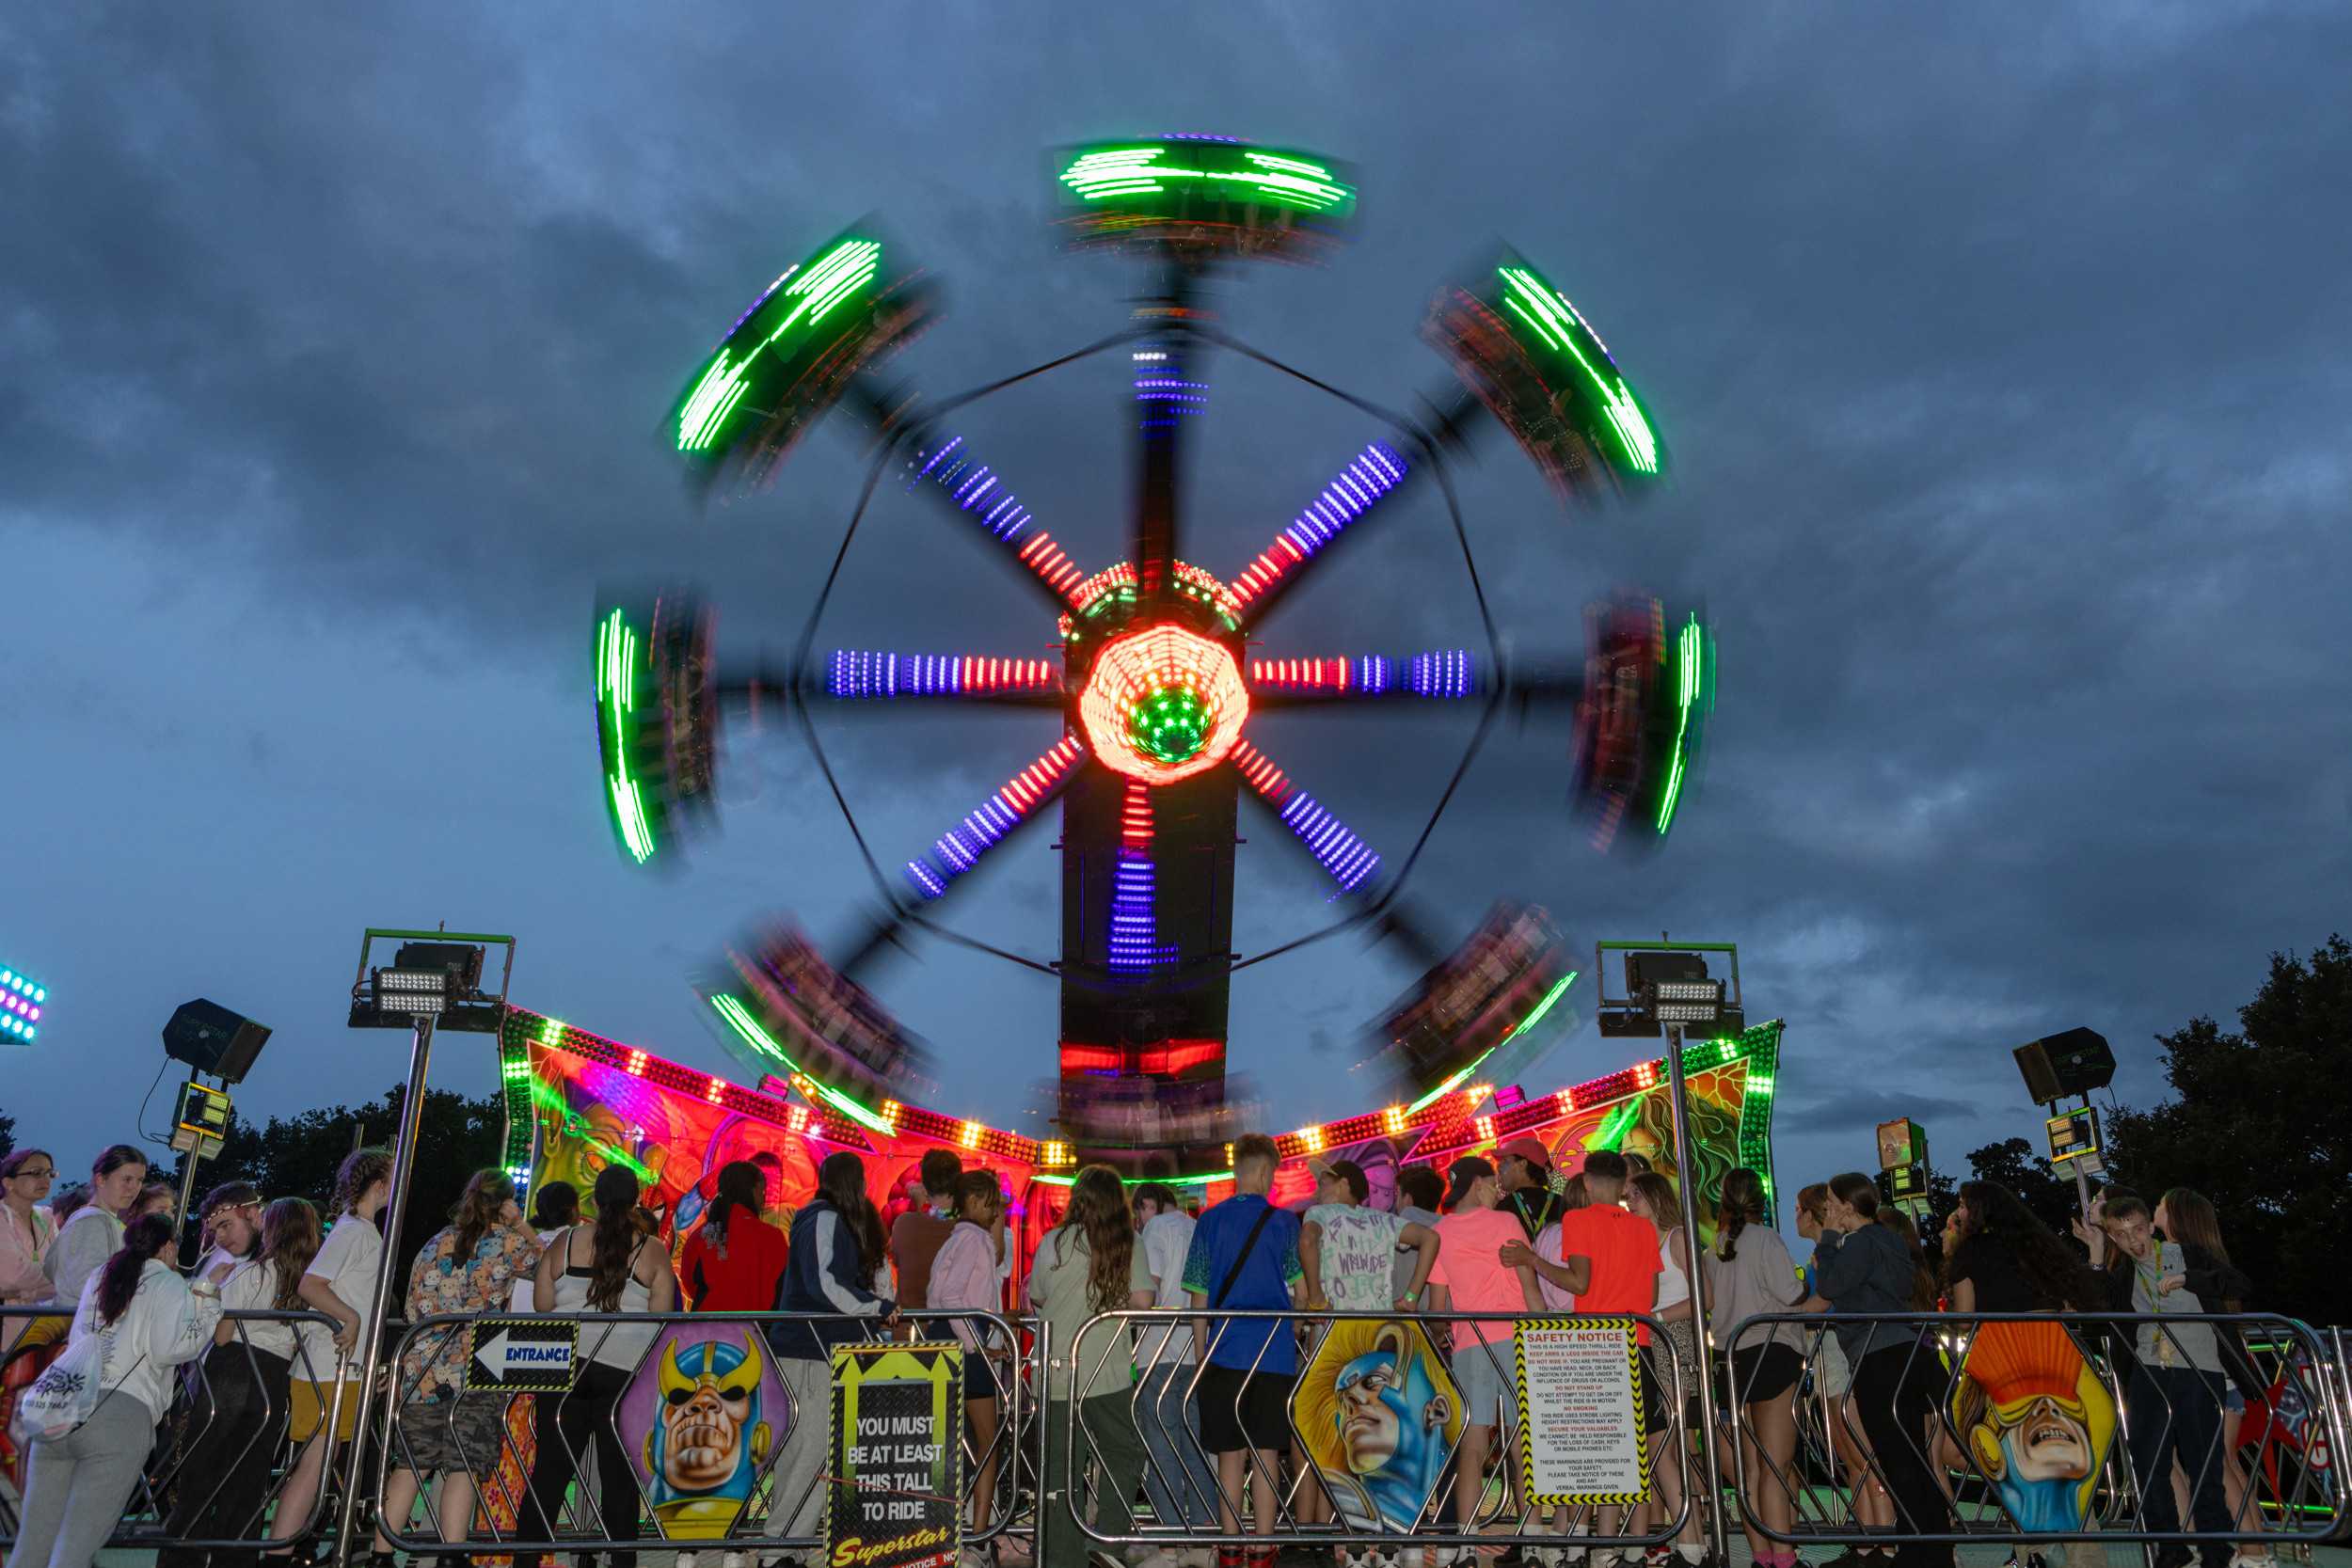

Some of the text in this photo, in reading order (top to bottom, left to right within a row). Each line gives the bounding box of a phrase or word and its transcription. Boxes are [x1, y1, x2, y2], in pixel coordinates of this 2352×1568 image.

[1527, 1333, 1622, 1342] SAFETY NOTICE
[505, 1347, 570, 1362] ENTRANCE
[856, 1417, 936, 1435] YOU MUST
[848, 1444, 943, 1465] BE AT LEAST
[856, 1473, 932, 1493] THIS TALL
[862, 1501, 925, 1521] TO RIDE
[832, 1526, 950, 1567] Superstar
